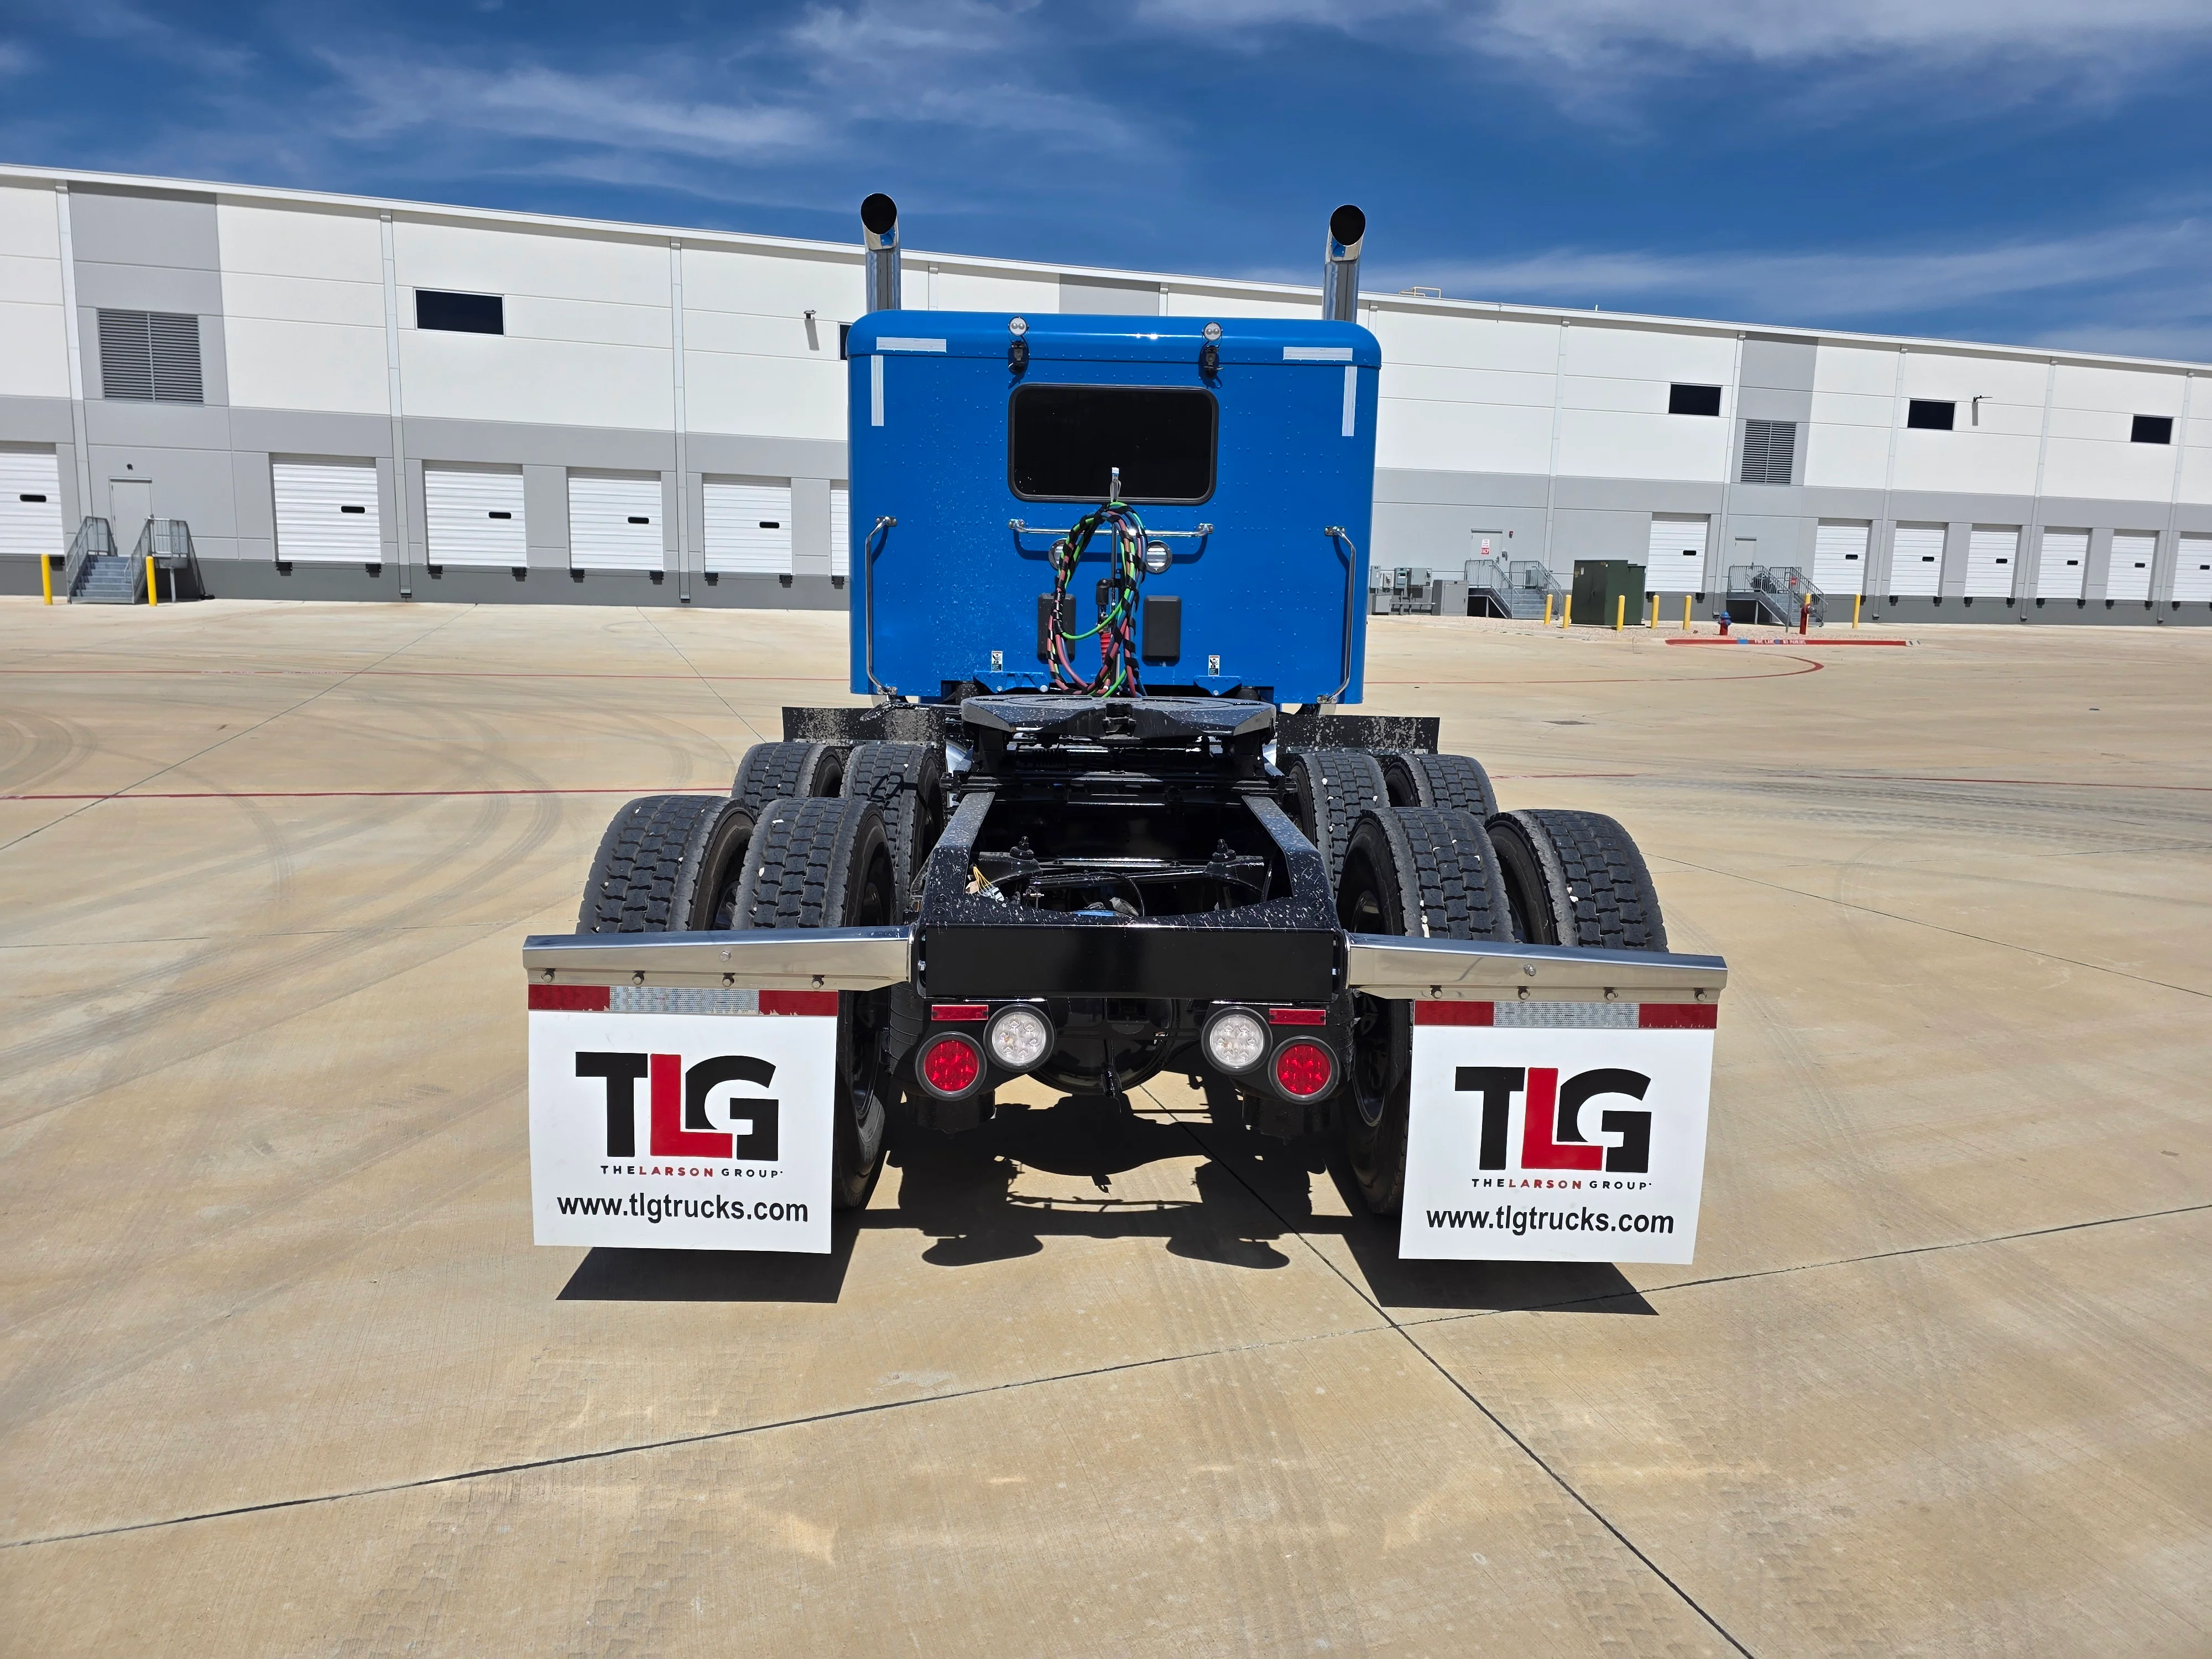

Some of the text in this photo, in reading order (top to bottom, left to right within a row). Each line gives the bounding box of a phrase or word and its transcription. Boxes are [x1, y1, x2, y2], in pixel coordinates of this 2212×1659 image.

[575, 1051, 779, 1162] TLG
[1454, 1066, 1652, 1173] TLG
[721, 1168, 779, 1178] GROUP
[1589, 1180, 1647, 1190] GROUP
[556, 1192, 808, 1224] www.tlgtrucks.com
[1426, 1205, 1674, 1236] www.tlgtrucks.com
